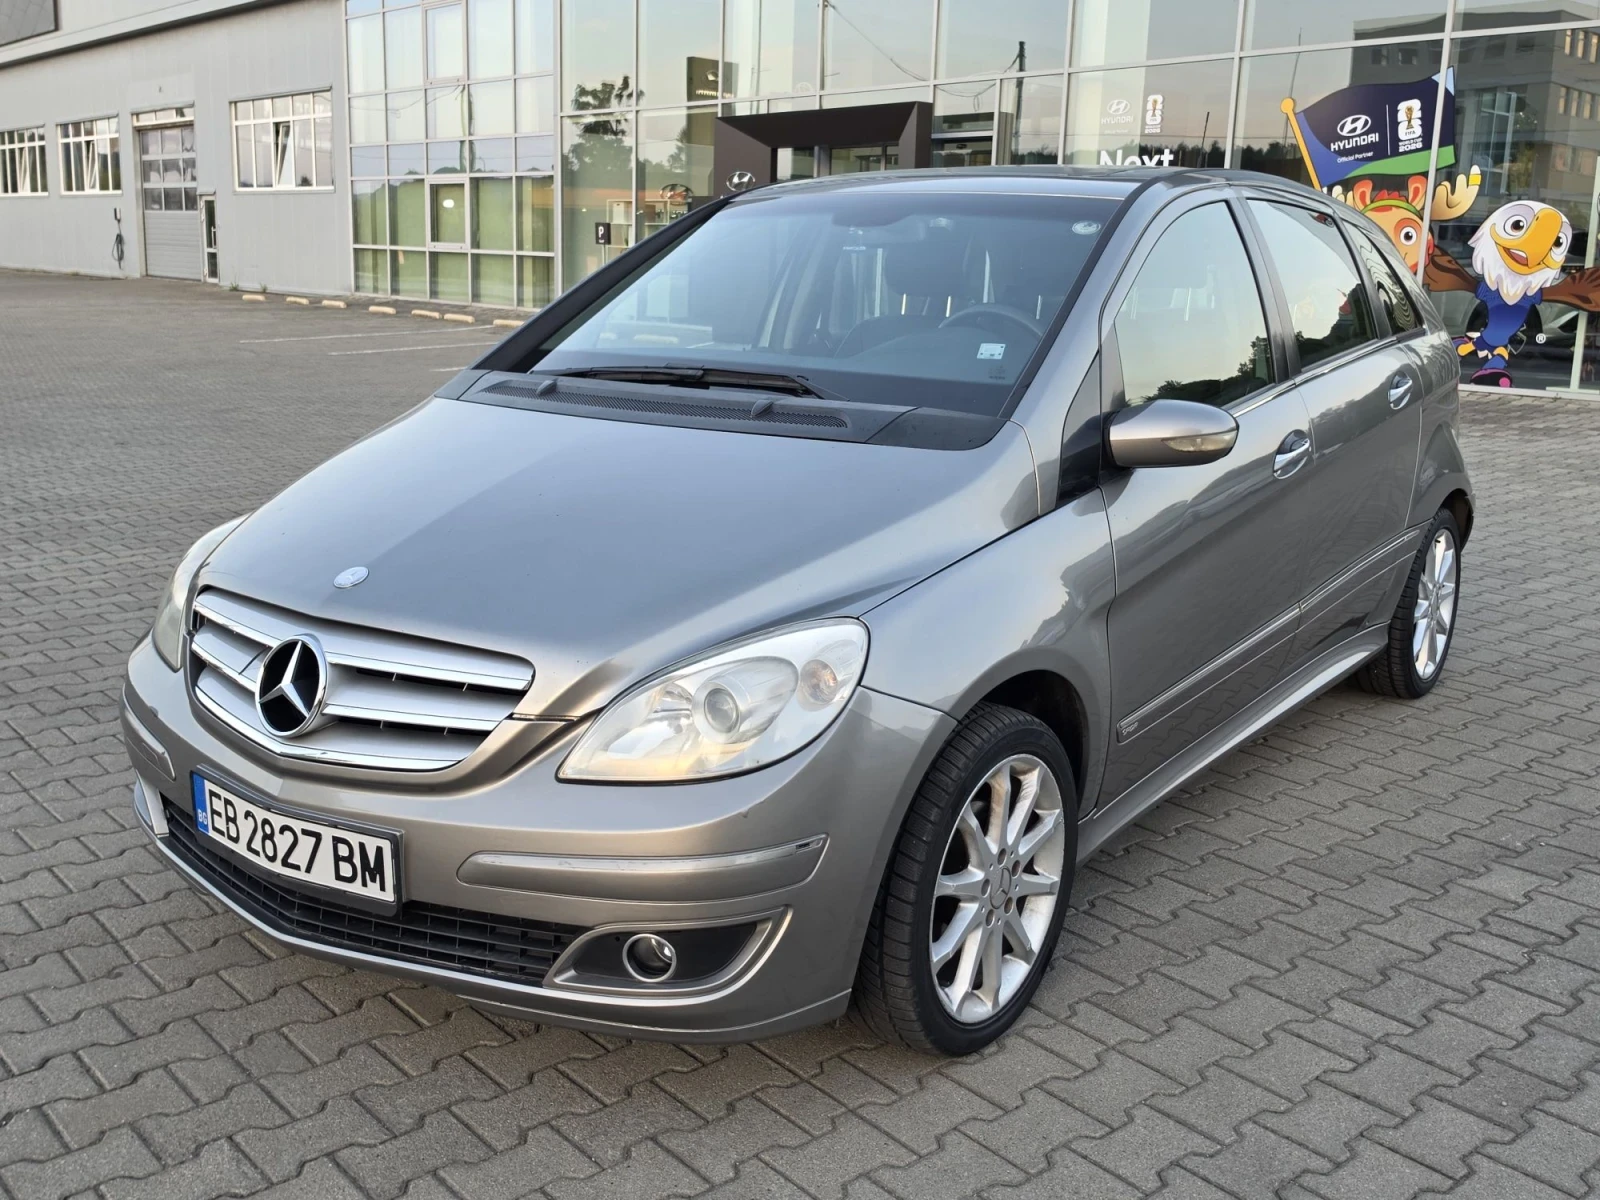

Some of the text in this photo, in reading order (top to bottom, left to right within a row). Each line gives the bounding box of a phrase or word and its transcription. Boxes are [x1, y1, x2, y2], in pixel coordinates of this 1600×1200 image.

[1101, 115, 1134, 125] HYUNDAI
[1330, 132, 1379, 152] HYUNDAI
[1398, 142, 1423, 152] 2026
[1336, 151, 1374, 163] Official Partner
[598, 226, 604, 238] P
[197, 809, 208, 825] BG
[208, 788, 386, 893] EB 2827 BM
